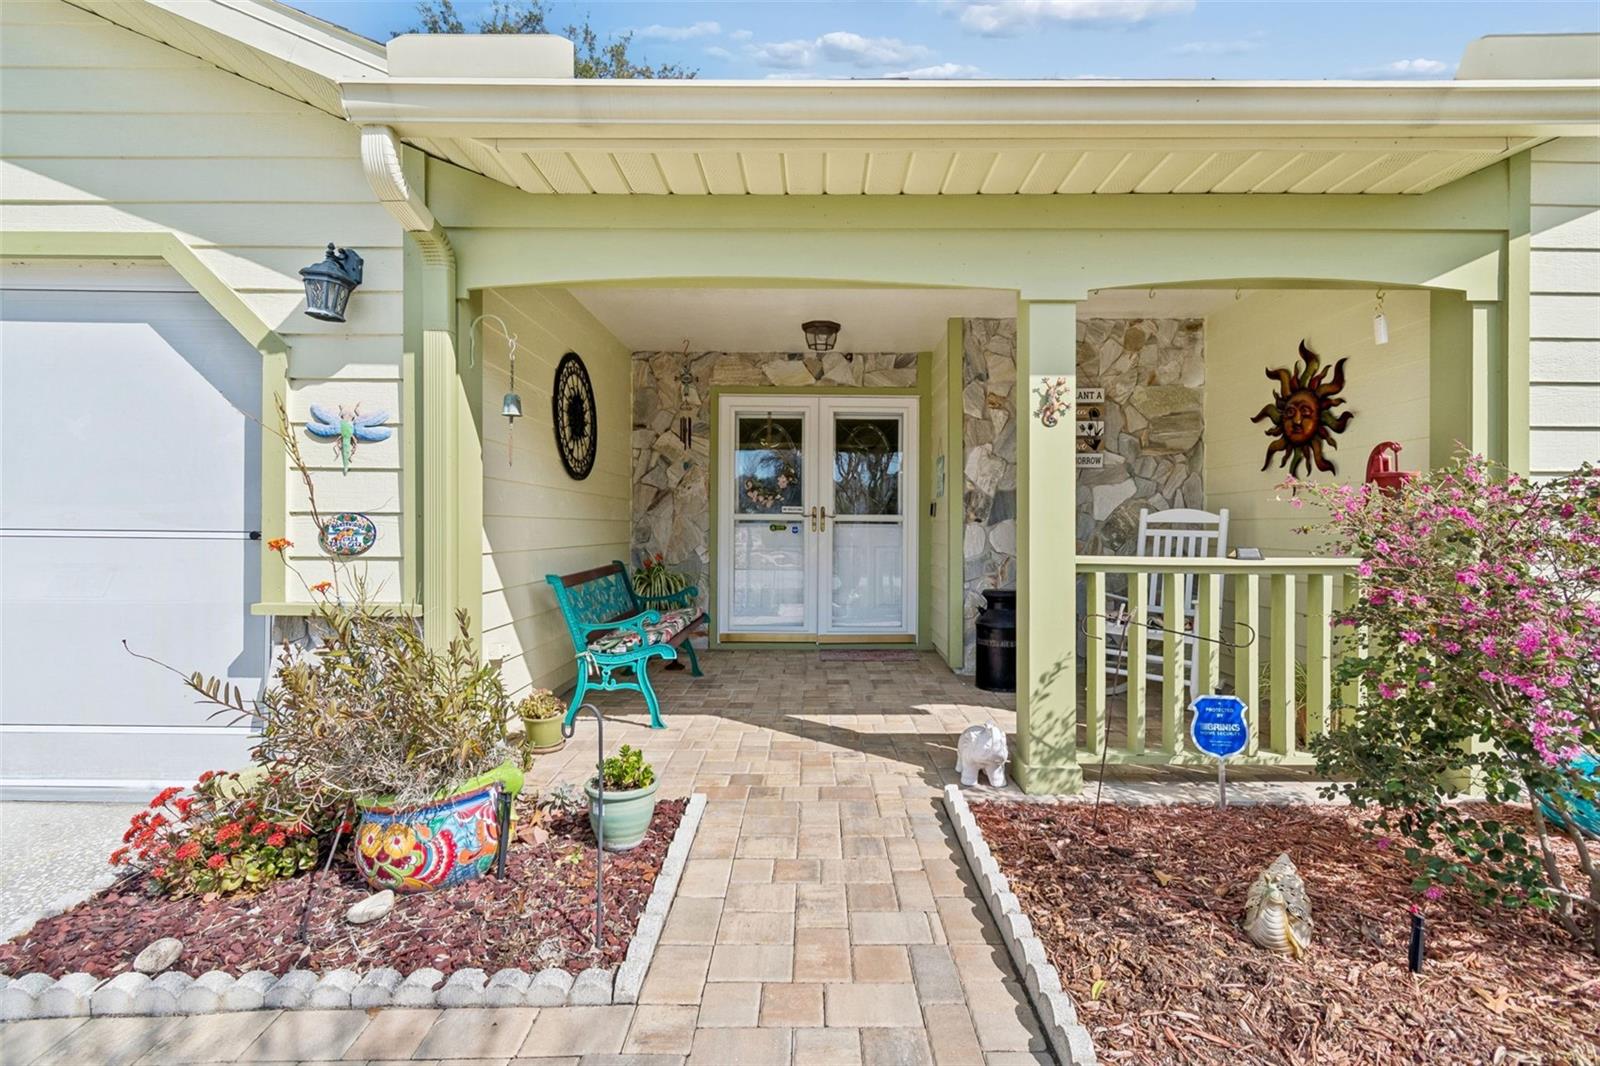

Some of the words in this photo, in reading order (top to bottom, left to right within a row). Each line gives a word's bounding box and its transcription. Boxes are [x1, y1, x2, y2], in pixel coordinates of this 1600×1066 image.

[1076, 391, 1094, 400] ANT
[1097, 391, 1102, 400] A
[1076, 456, 1101, 465] ORROW
[1208, 723, 1241, 732] BRINKS
